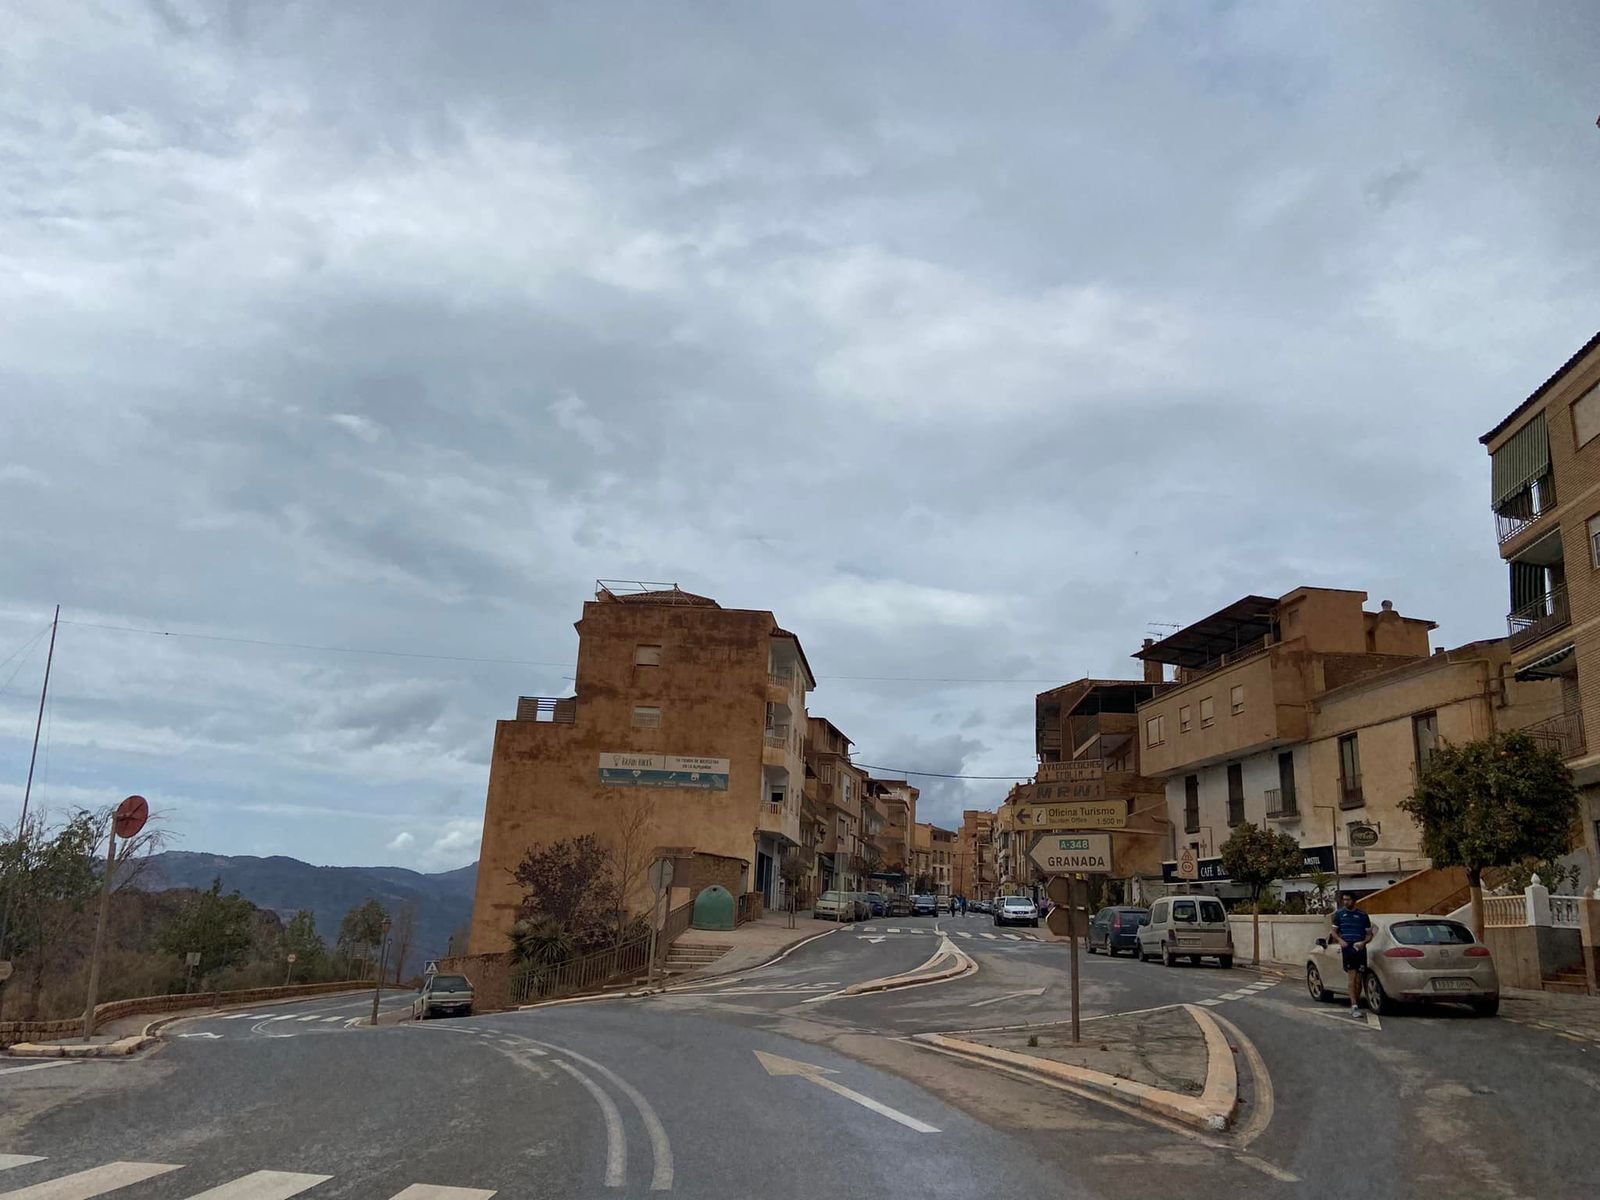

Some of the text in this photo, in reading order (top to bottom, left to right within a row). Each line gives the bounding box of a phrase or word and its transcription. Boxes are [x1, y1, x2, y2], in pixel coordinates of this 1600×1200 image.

[1048, 807, 1116, 817] Oficina Turismo
[1060, 840, 1088, 849] A-348
[1047, 856, 1105, 867] GRANADA
